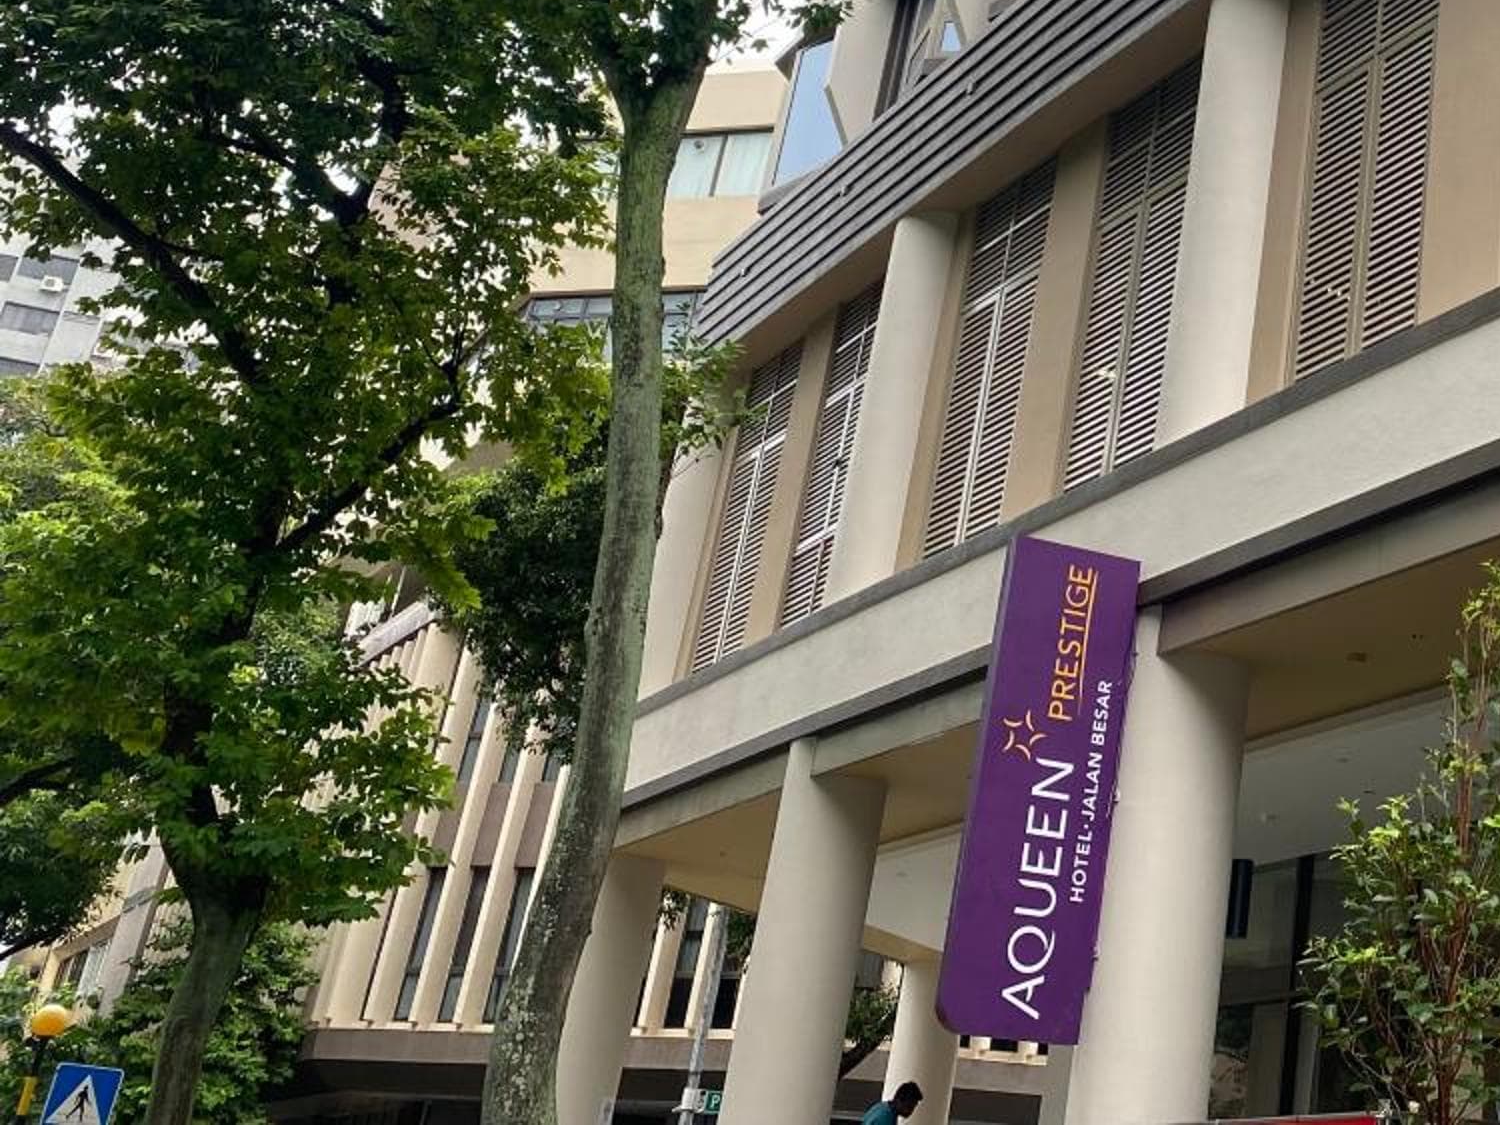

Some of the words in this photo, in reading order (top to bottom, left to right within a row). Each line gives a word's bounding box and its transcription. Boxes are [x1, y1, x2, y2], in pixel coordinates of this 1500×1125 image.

[1001, 757, 1075, 1020] AQUEEN
[1047, 564, 1096, 721] PRESTIGE
[1090, 680, 1113, 746] BESAR
